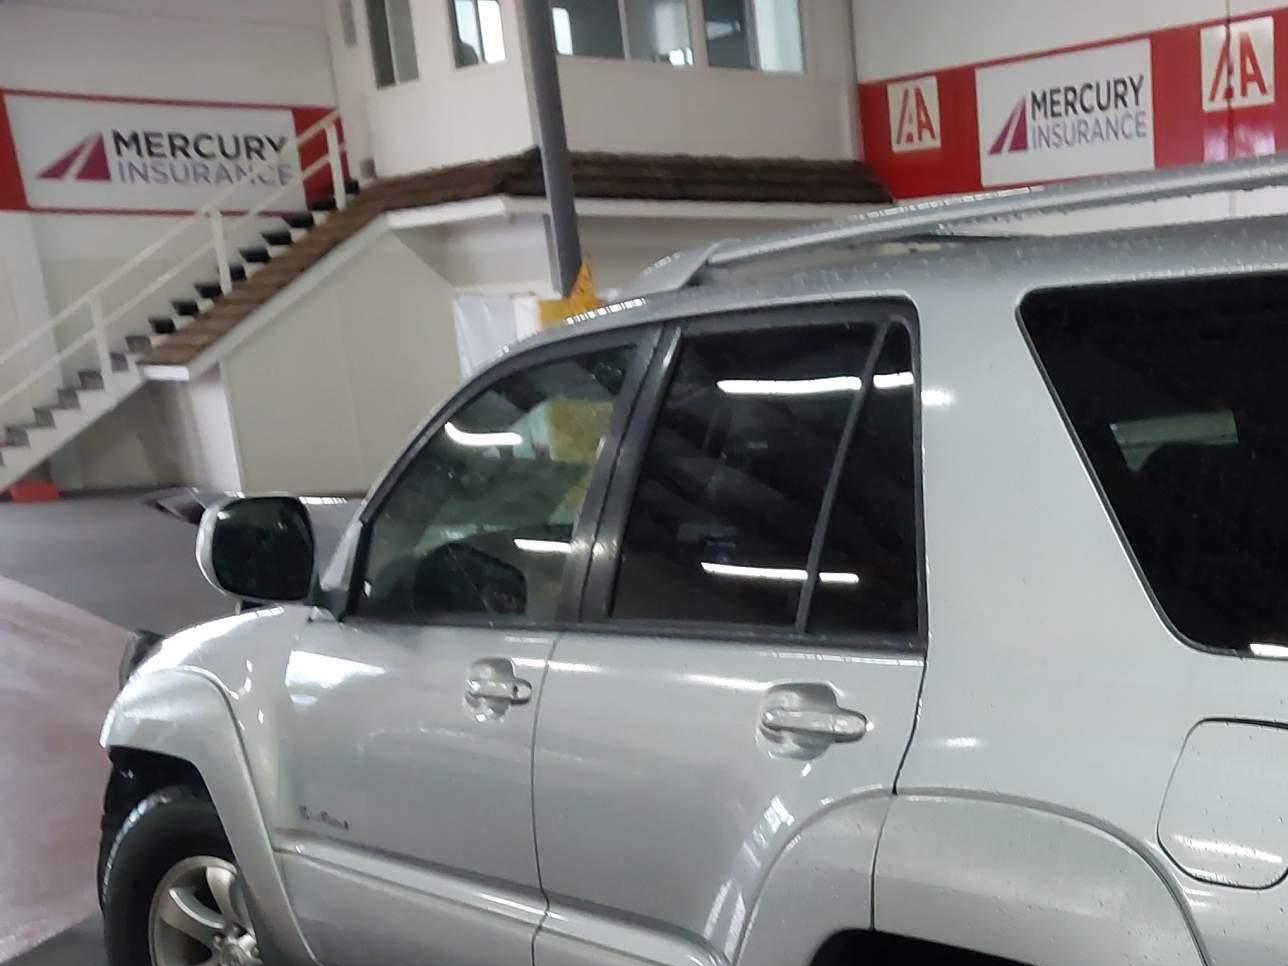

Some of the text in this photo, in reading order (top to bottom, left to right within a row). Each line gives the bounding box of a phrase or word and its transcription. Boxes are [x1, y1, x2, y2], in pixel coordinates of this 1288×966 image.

[1031, 74, 1144, 120] MERCURY
[111, 128, 287, 161] MERCURY
[1032, 111, 1147, 150] INSURANCE
